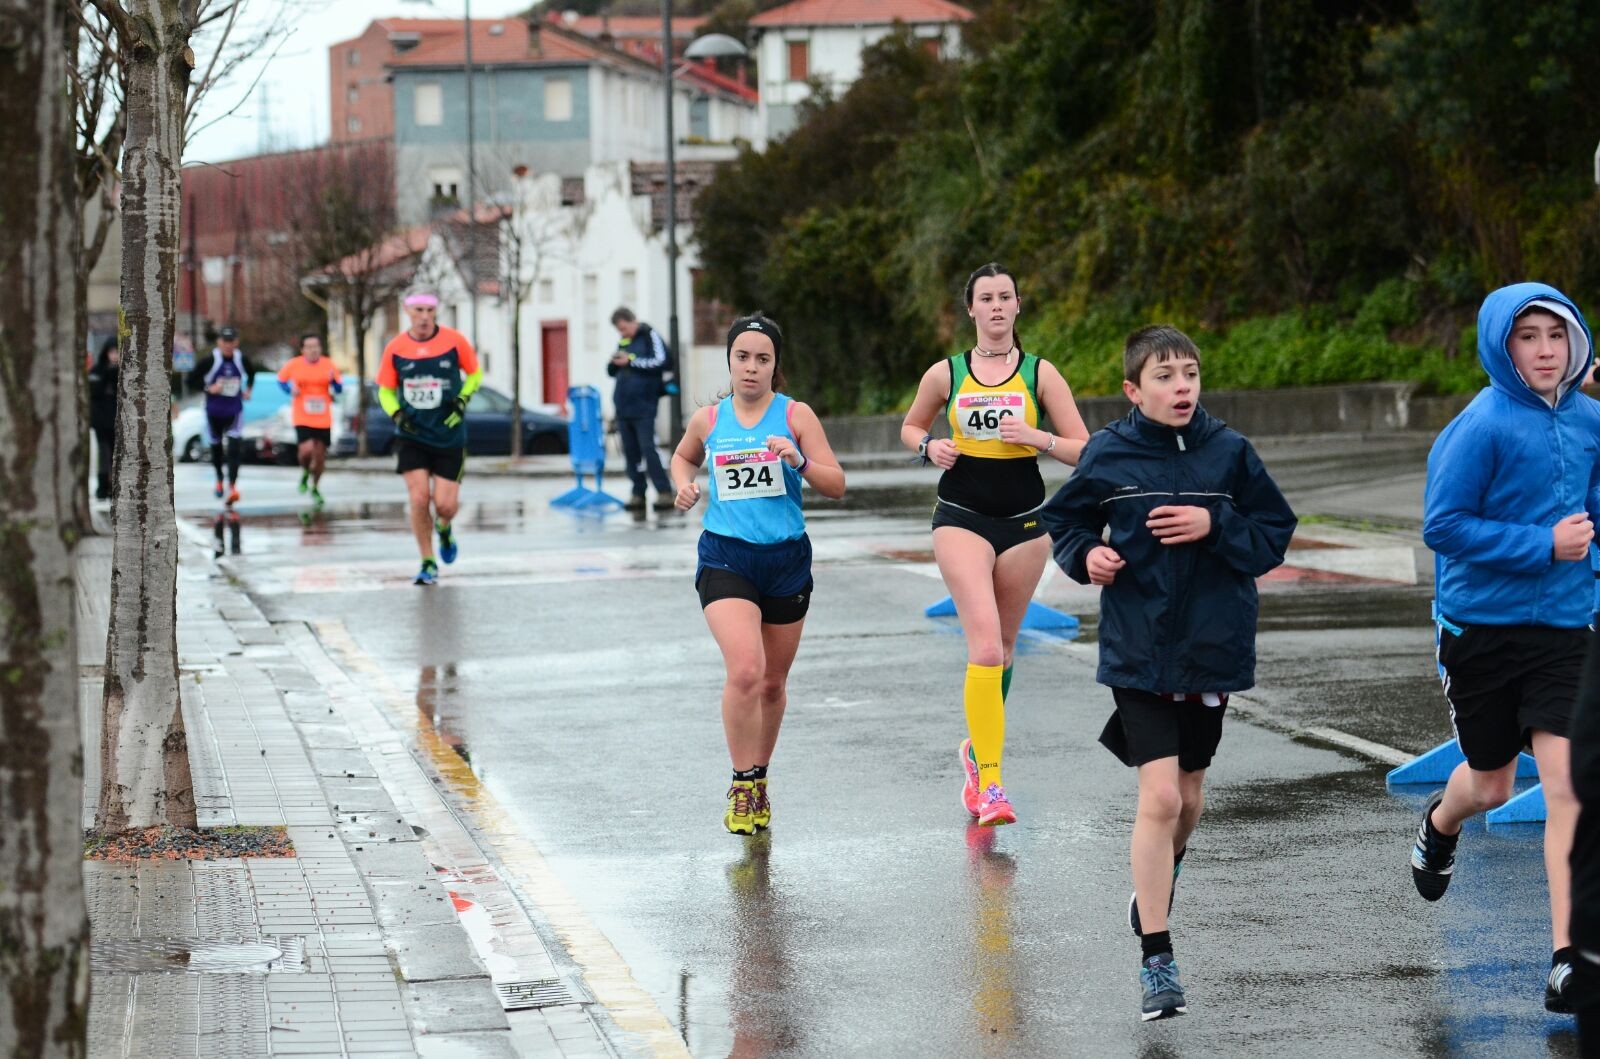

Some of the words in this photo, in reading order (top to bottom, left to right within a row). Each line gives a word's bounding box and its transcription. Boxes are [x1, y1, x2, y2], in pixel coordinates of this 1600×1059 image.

[411, 390, 435, 401] 224
[725, 453, 758, 461] LABORAL
[725, 465, 774, 490] 324
